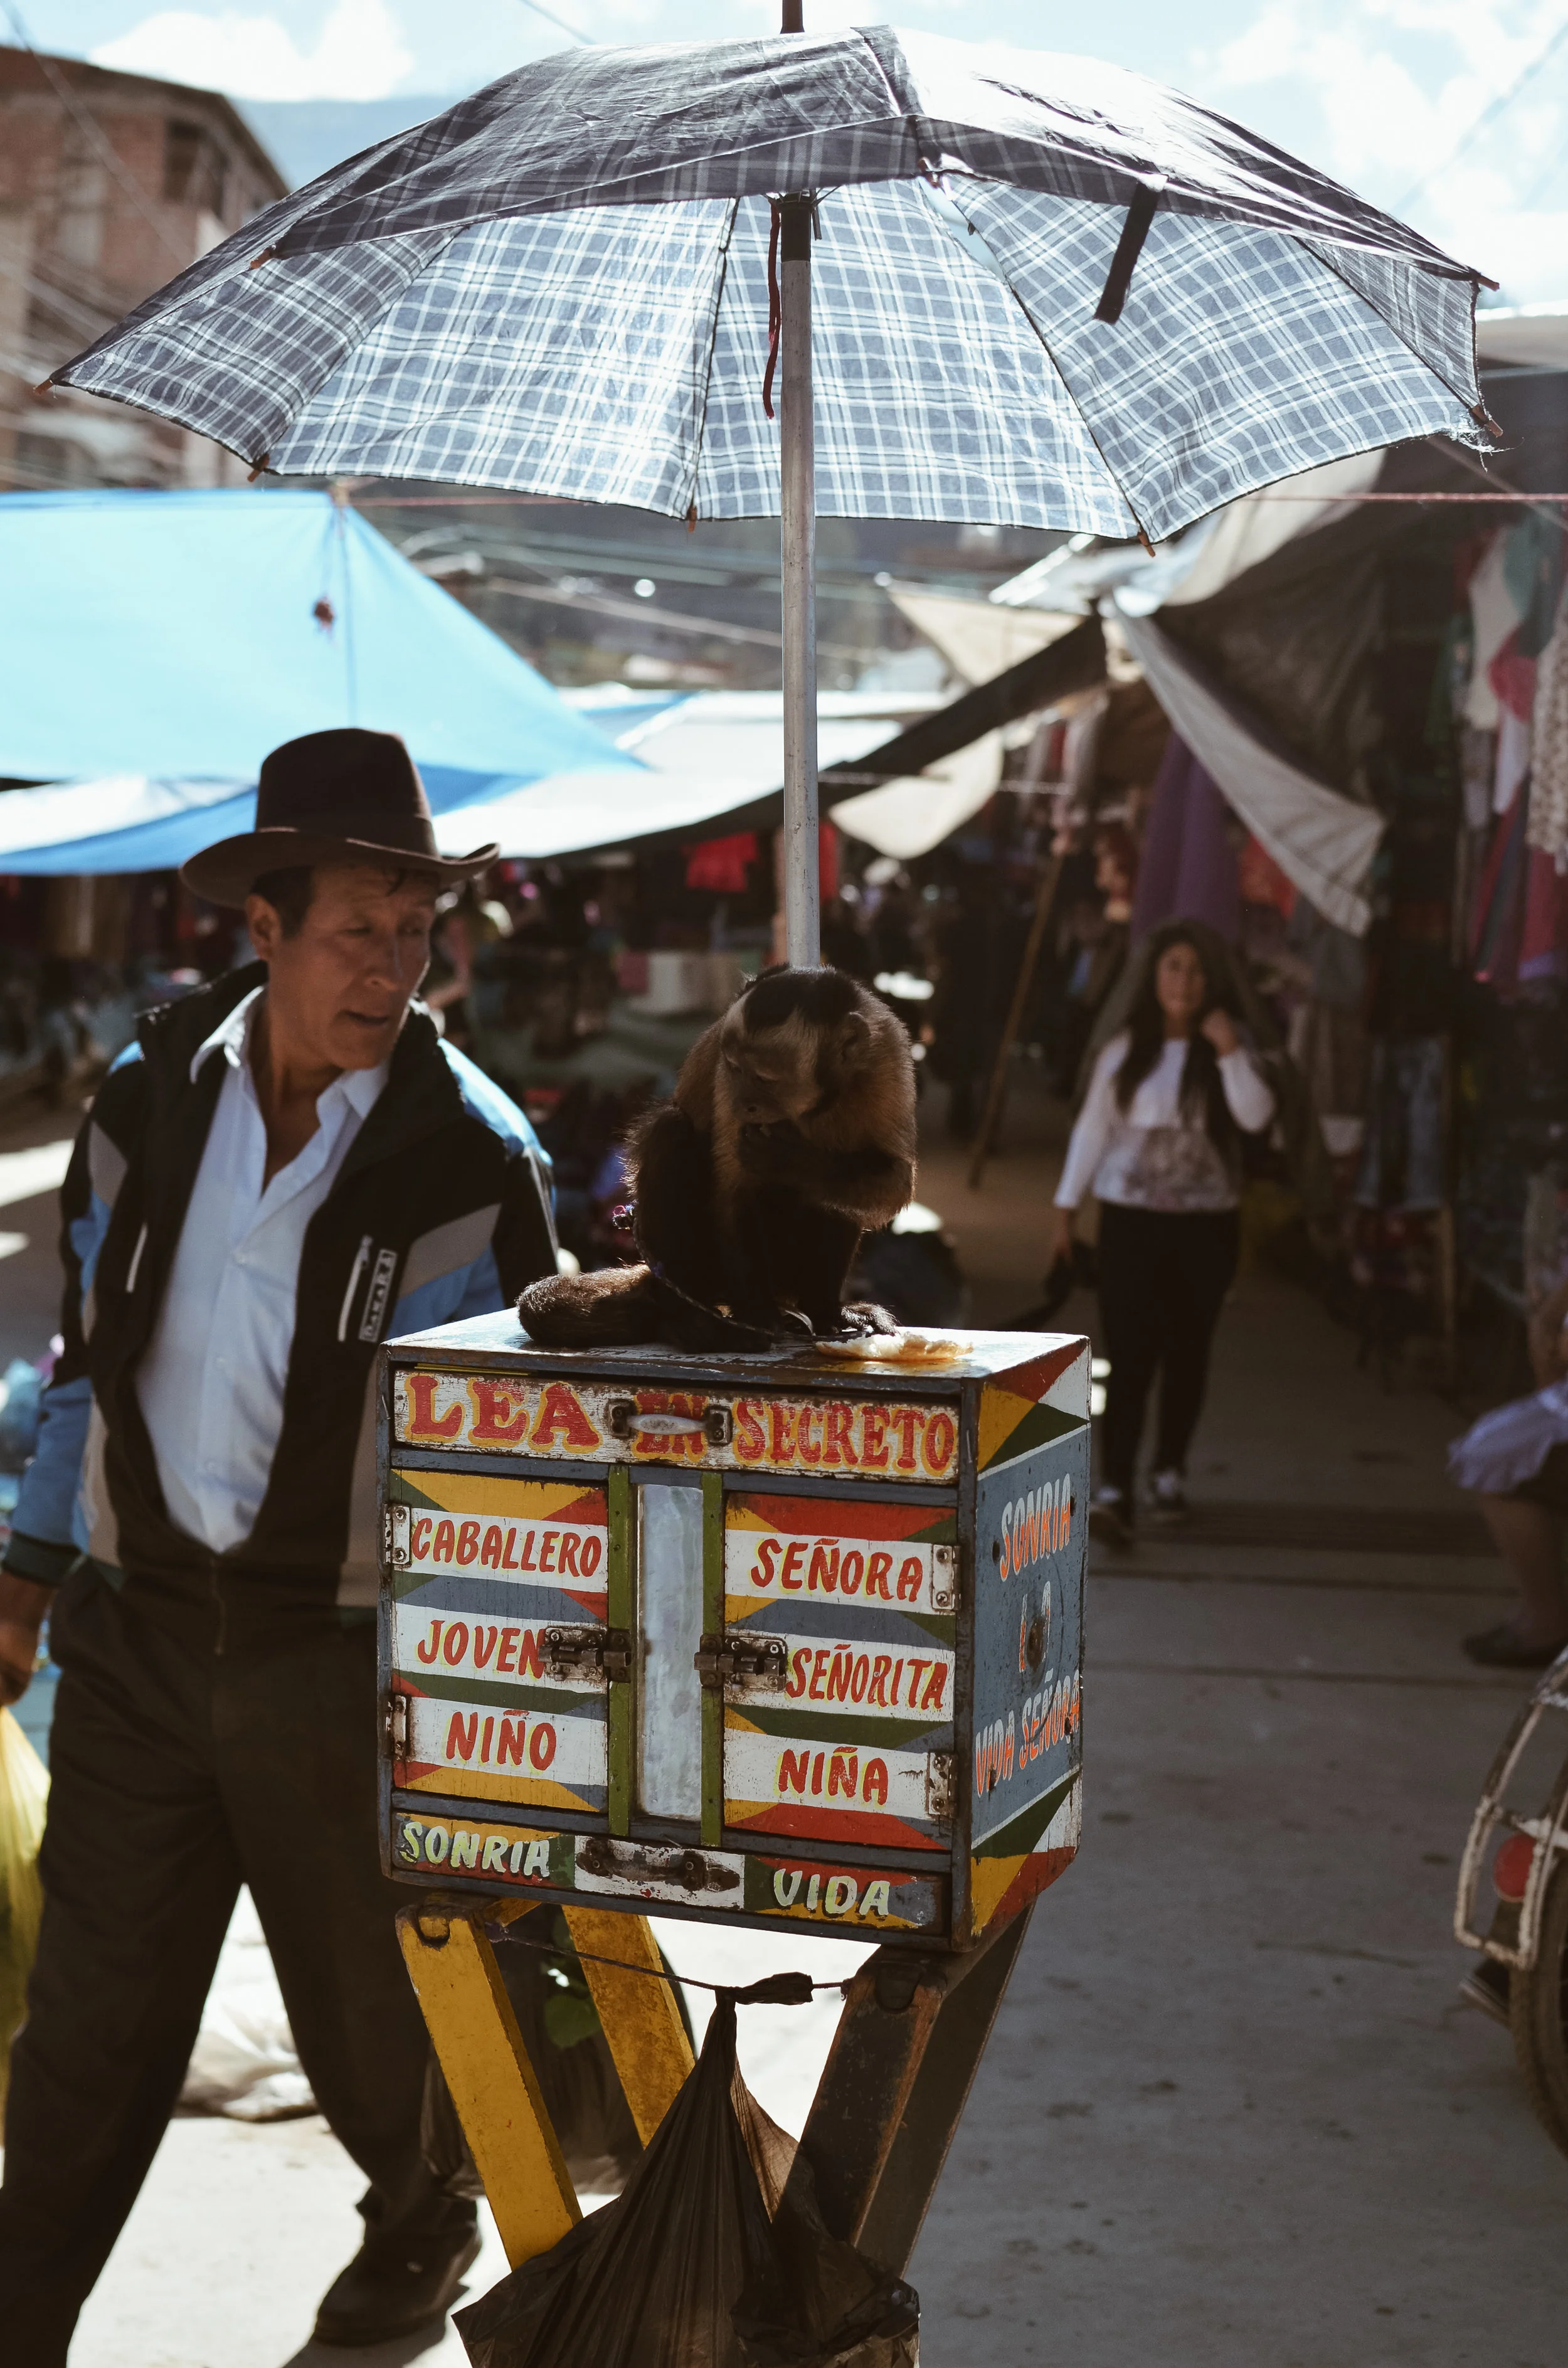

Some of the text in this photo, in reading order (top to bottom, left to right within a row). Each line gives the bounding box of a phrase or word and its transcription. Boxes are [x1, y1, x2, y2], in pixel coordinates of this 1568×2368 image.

[405, 1373, 603, 1453] LEA
[733, 1396, 956, 1476] SECRETO
[411, 1518, 601, 1578] CABALLERO
[1000, 1473, 1071, 1582] SONRIA
[751, 1538, 923, 1602] SEÑORA
[417, 1620, 546, 1679] JOVEN
[785, 1643, 948, 1711] SEÑORITA
[445, 1709, 557, 1771] NIÑO
[1019, 1668, 1079, 1770] SEÑORA
[777, 1746, 889, 1806] NIÑA
[399, 1821, 890, 1918] SONRIA VIDA
